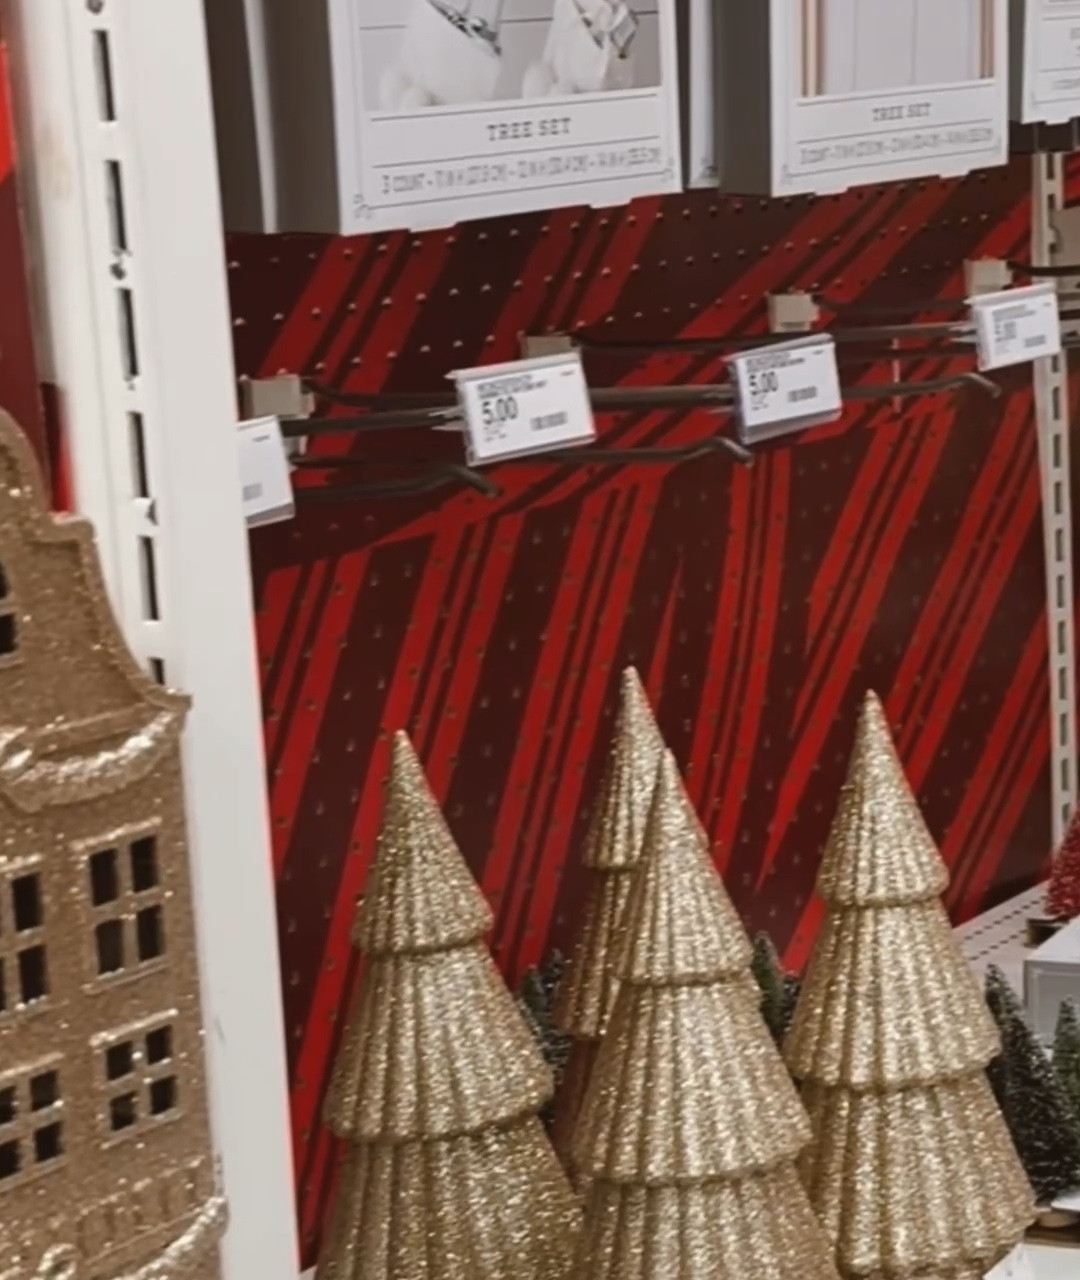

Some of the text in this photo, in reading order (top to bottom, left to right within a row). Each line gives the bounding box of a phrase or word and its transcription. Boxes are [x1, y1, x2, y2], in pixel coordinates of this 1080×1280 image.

[485, 116, 572, 142] TREE SET
[481, 395, 519, 426] 5.00
